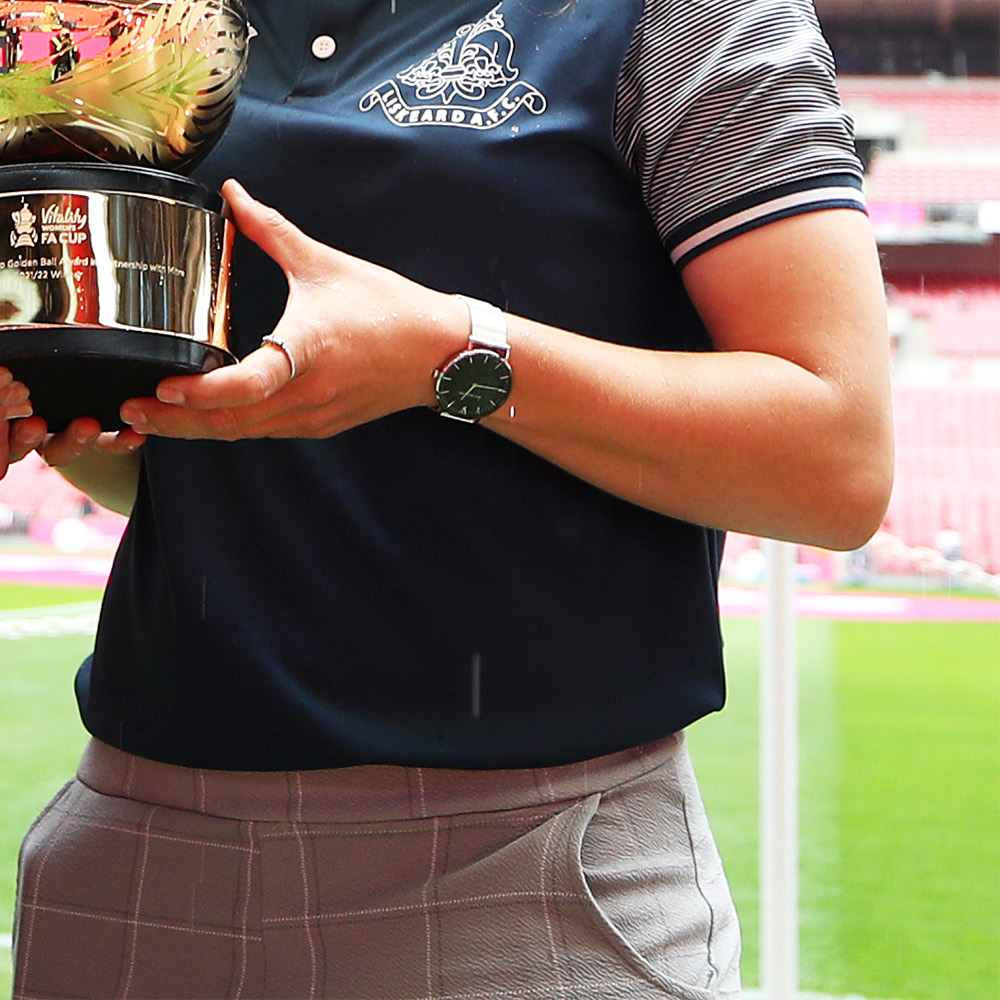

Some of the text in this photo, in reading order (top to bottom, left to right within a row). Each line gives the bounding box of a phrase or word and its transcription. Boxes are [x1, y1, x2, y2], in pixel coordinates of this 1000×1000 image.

[382, 89, 466, 123] LISKEARD
[41, 203, 88, 230] Vitality
[41, 232, 88, 245] FA CUP
[7, 258, 38, 268] Golden
[40, 256, 57, 267] Ball
